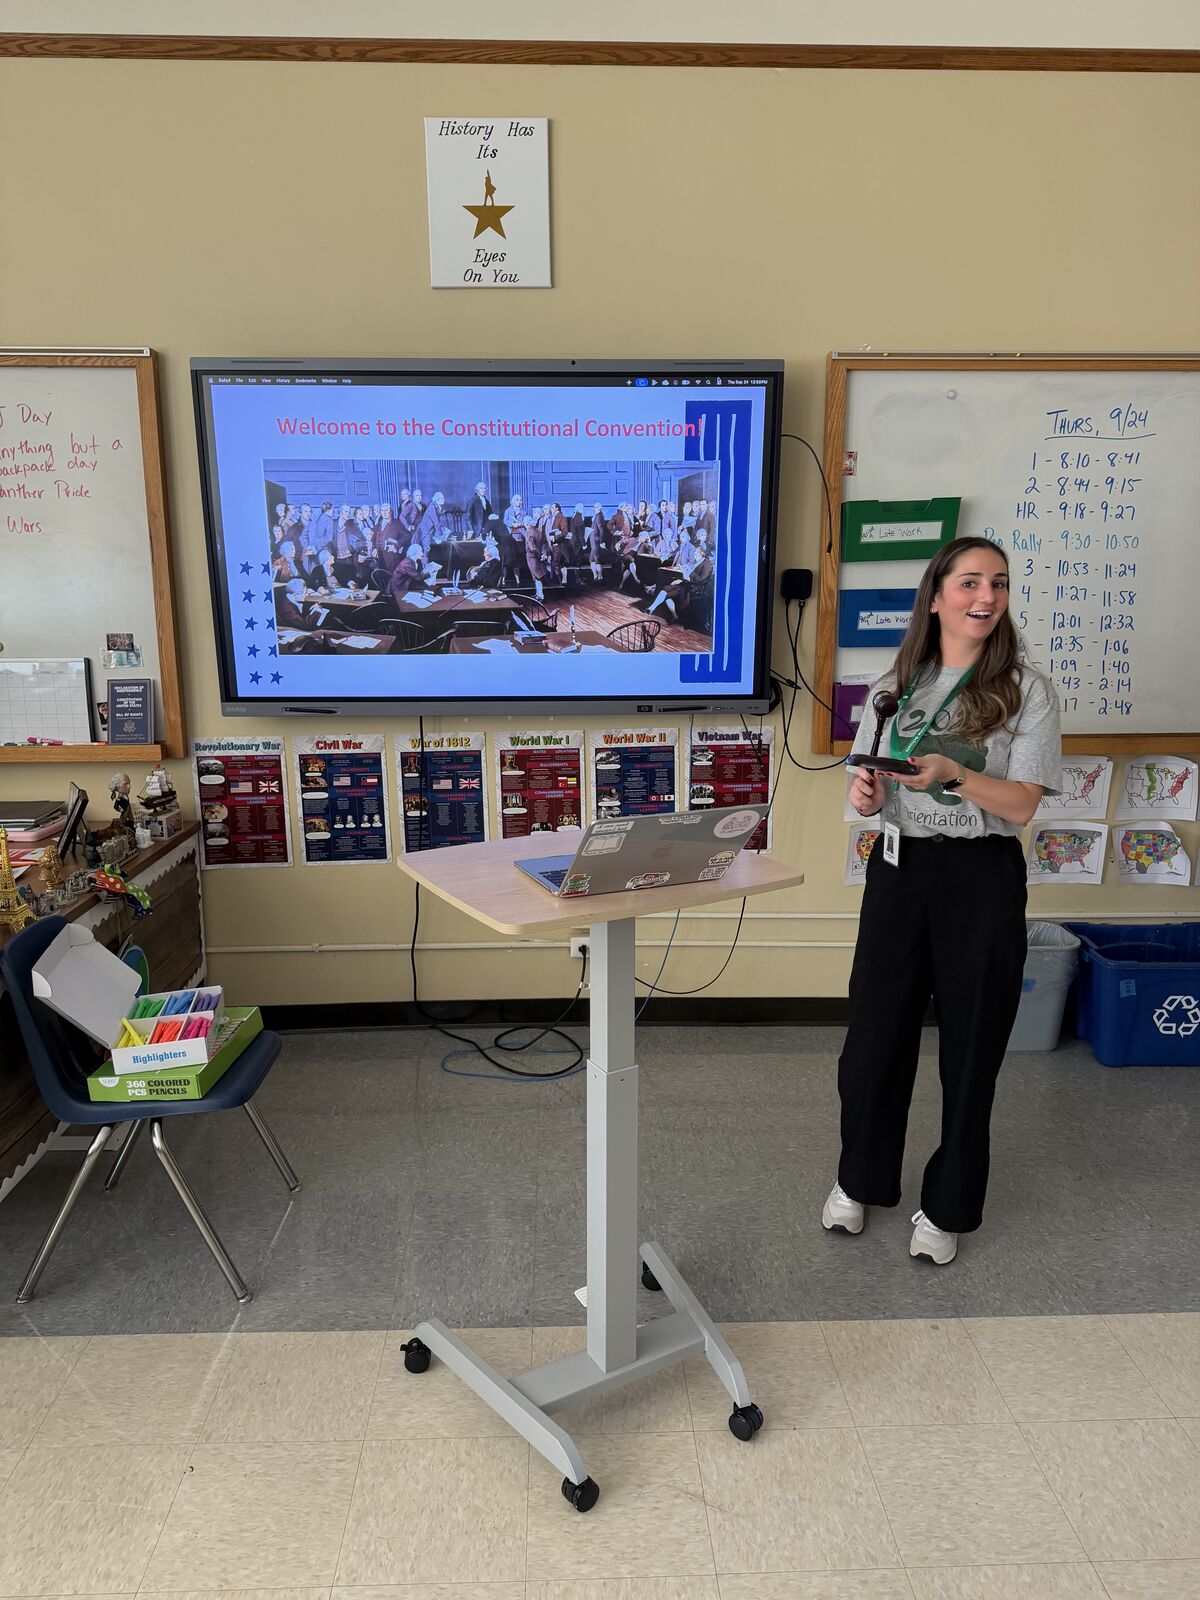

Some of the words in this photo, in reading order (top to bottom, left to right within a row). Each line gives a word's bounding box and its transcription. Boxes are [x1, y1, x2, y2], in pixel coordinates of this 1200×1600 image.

[438, 121, 494, 141] History
[507, 122, 535, 137] Has
[476, 145, 498, 159] Its
[473, 249, 507, 267] Eyes
[463, 268, 483, 283] On
[493, 269, 520, 283] You
[17, 403, 52, 426] Day
[1109, 403, 1148, 436] 9/24
[276, 417, 370, 436] Welcome
[376, 419, 397, 436] to
[402, 417, 435, 436] the
[441, 418, 579, 437] Constitutional
[585, 419, 703, 437] Convention!
[0, 440, 54, 463] nything
[71, 433, 100, 455] but
[112, 439, 123, 450] a
[67, 456, 98, 472] day
[1032, 452, 1037, 470] 1
[1061, 452, 1090, 469] 8:10
[1107, 452, 1140, 467] 8:41
[0, 483, 45, 499] anther
[54, 480, 92, 498] Pride
[1025, 477, 1040, 494] 2
[1057, 477, 1090, 496] 8:44
[1105, 476, 1142, 494] 9:15
[1016, 501, 1039, 519] HR
[1059, 502, 1086, 520] 9:18
[1101, 501, 1135, 522] 9:27
[7, 516, 42, 534] Wars
[880, 527, 895, 538] Late
[900, 526, 923, 537] Work
[1013, 529, 1042, 555] Rally
[1061, 530, 1091, 550] 9:30
[1106, 534, 1139, 549] 10:50
[1024, 559, 1034, 576] 3
[1057, 560, 1089, 577] 10:53
[1105, 563, 1136, 580] 11:24
[1021, 585, 1031, 602] 4
[1056, 586, 1087, 601] 11:27
[1103, 590, 1137, 607] 11:58
[876, 614, 891, 624] Late
[1019, 611, 1028, 629] 5
[1053, 612, 1081, 631] 12:01
[1100, 615, 1135, 632] 12:32
[1050, 636, 1086, 652] 12:35
[1104, 639, 1129, 655] 1:06
[1050, 659, 1077, 673] 1:09
[1102, 660, 1130, 675] 1:40
[1099, 678, 1131, 693] 2:14
[1064, 697, 1078, 712] 17
[1099, 697, 1133, 715] 2:48
[315, 740, 340, 750] Civil
[345, 740, 363, 750] War
[432, 737, 444, 748] of
[446, 736, 471, 748] 1812
[510, 736, 541, 746] World
[543, 736, 563, 745] War
[565, 735, 570, 744] I
[602, 733, 634, 744] World
[636, 733, 656, 743] War
[659, 733, 666, 742] II
[697, 731, 739, 741] Vietnam
[741, 731, 763, 741] War
[194, 741, 260, 751] Revolutionary
[261, 741, 281, 750] War
[132, 1051, 187, 1065] Highlighters
[126, 1080, 146, 1088] 360
[147, 1078, 191, 1087] COLORED
[128, 1088, 147, 1096] PCS
[149, 1087, 187, 1095] PENCILS
